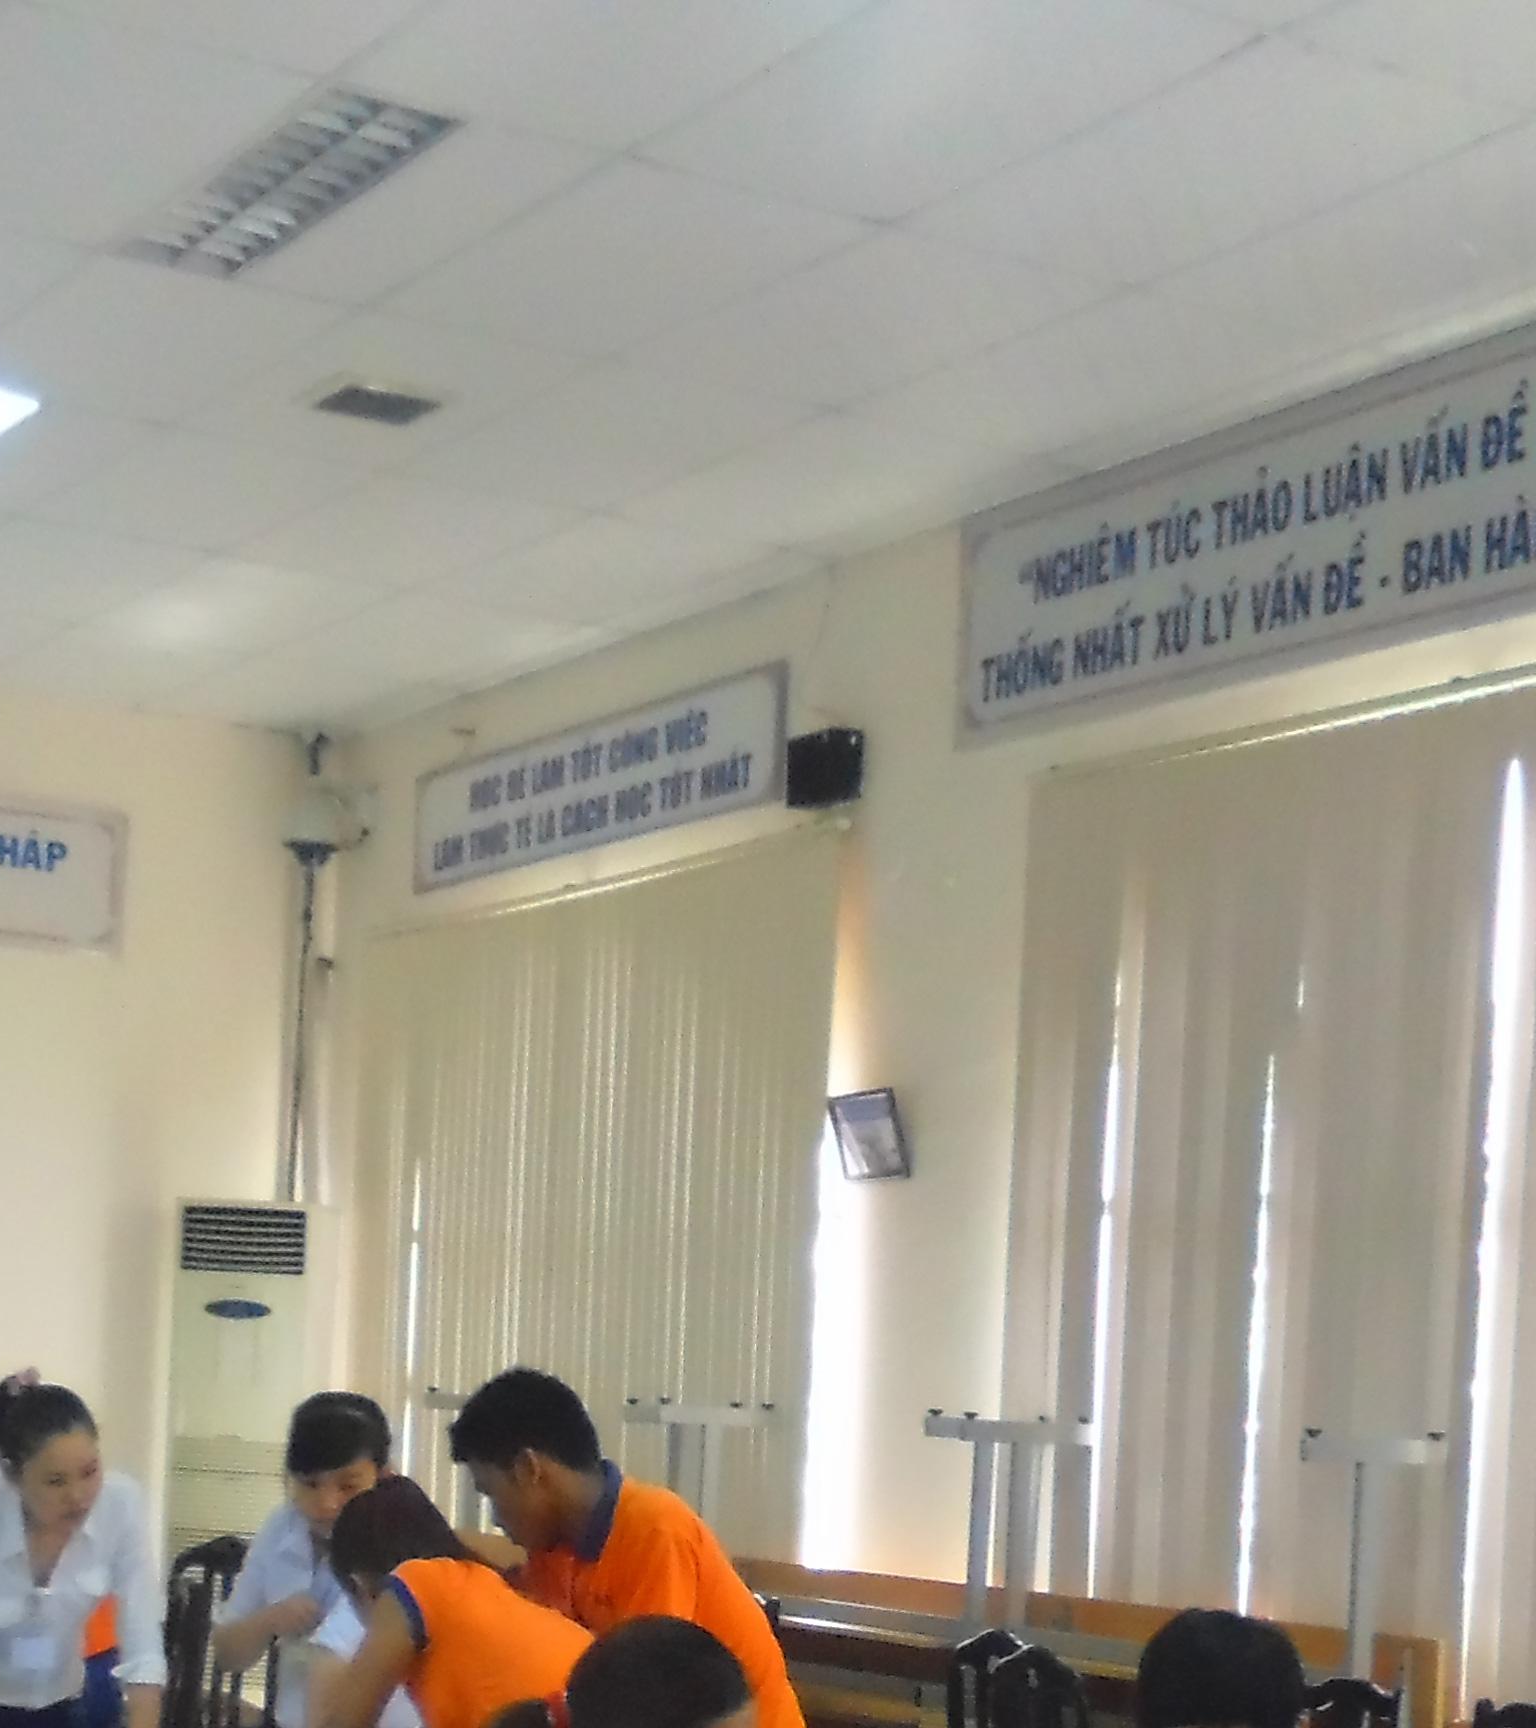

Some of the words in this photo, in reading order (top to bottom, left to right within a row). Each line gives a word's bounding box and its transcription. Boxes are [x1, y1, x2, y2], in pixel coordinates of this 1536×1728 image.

[1211, 464, 1292, 550] THẢO
[1302, 442, 1389, 525] LUẬN
[1400, 404, 1468, 495] VẤN
[981, 627, 1065, 702] THỐNG
[1072, 599, 1146, 679] NHẤT
[1202, 575, 1239, 646] LÝ
[1251, 553, 1312, 634] VẤN
[1403, 525, 1472, 593] BAN
